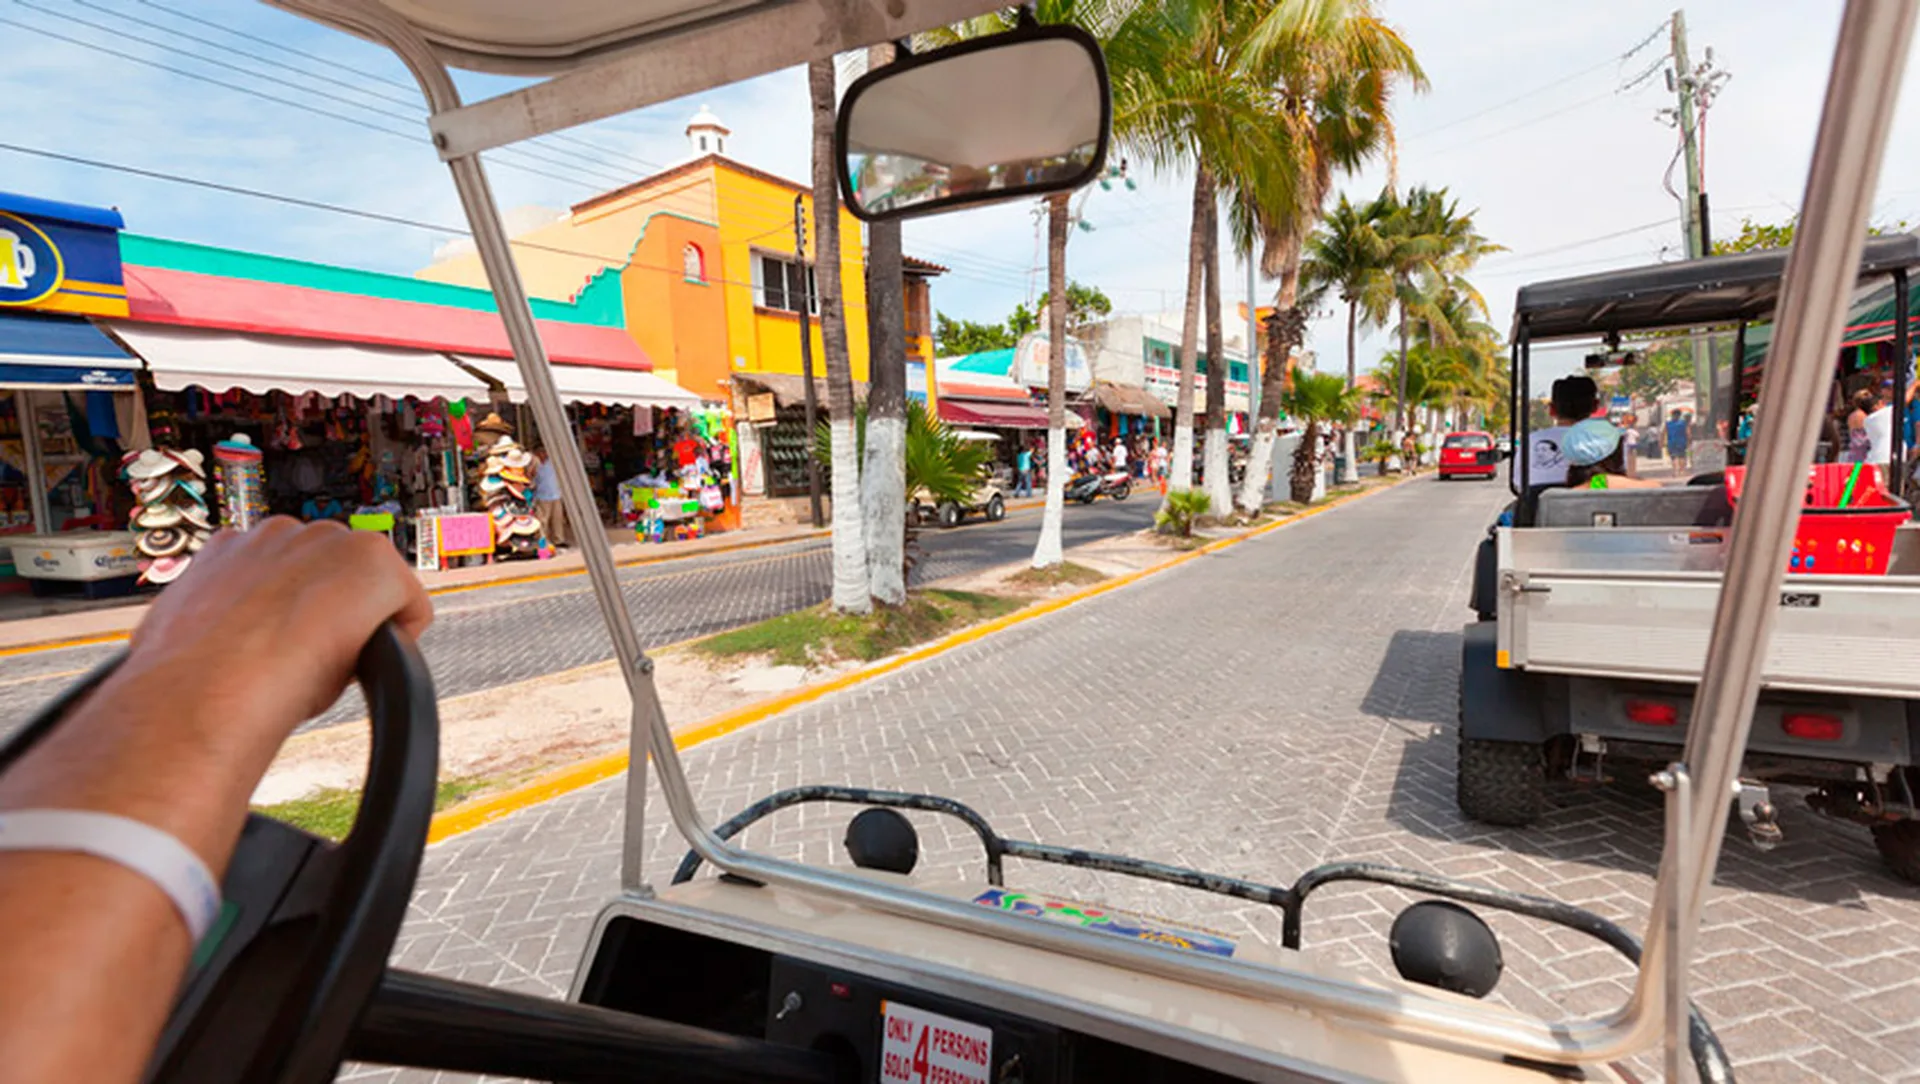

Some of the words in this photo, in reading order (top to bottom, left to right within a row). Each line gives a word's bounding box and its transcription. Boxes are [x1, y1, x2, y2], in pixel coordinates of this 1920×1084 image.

[1783, 594, 1814, 607] Car
[887, 1015, 913, 1043] ONLY
[913, 1024, 929, 1084] 4
[933, 1027, 987, 1066] PERSONS
[884, 1051, 911, 1081] SOLO
[930, 1064, 986, 1084] PERSO
